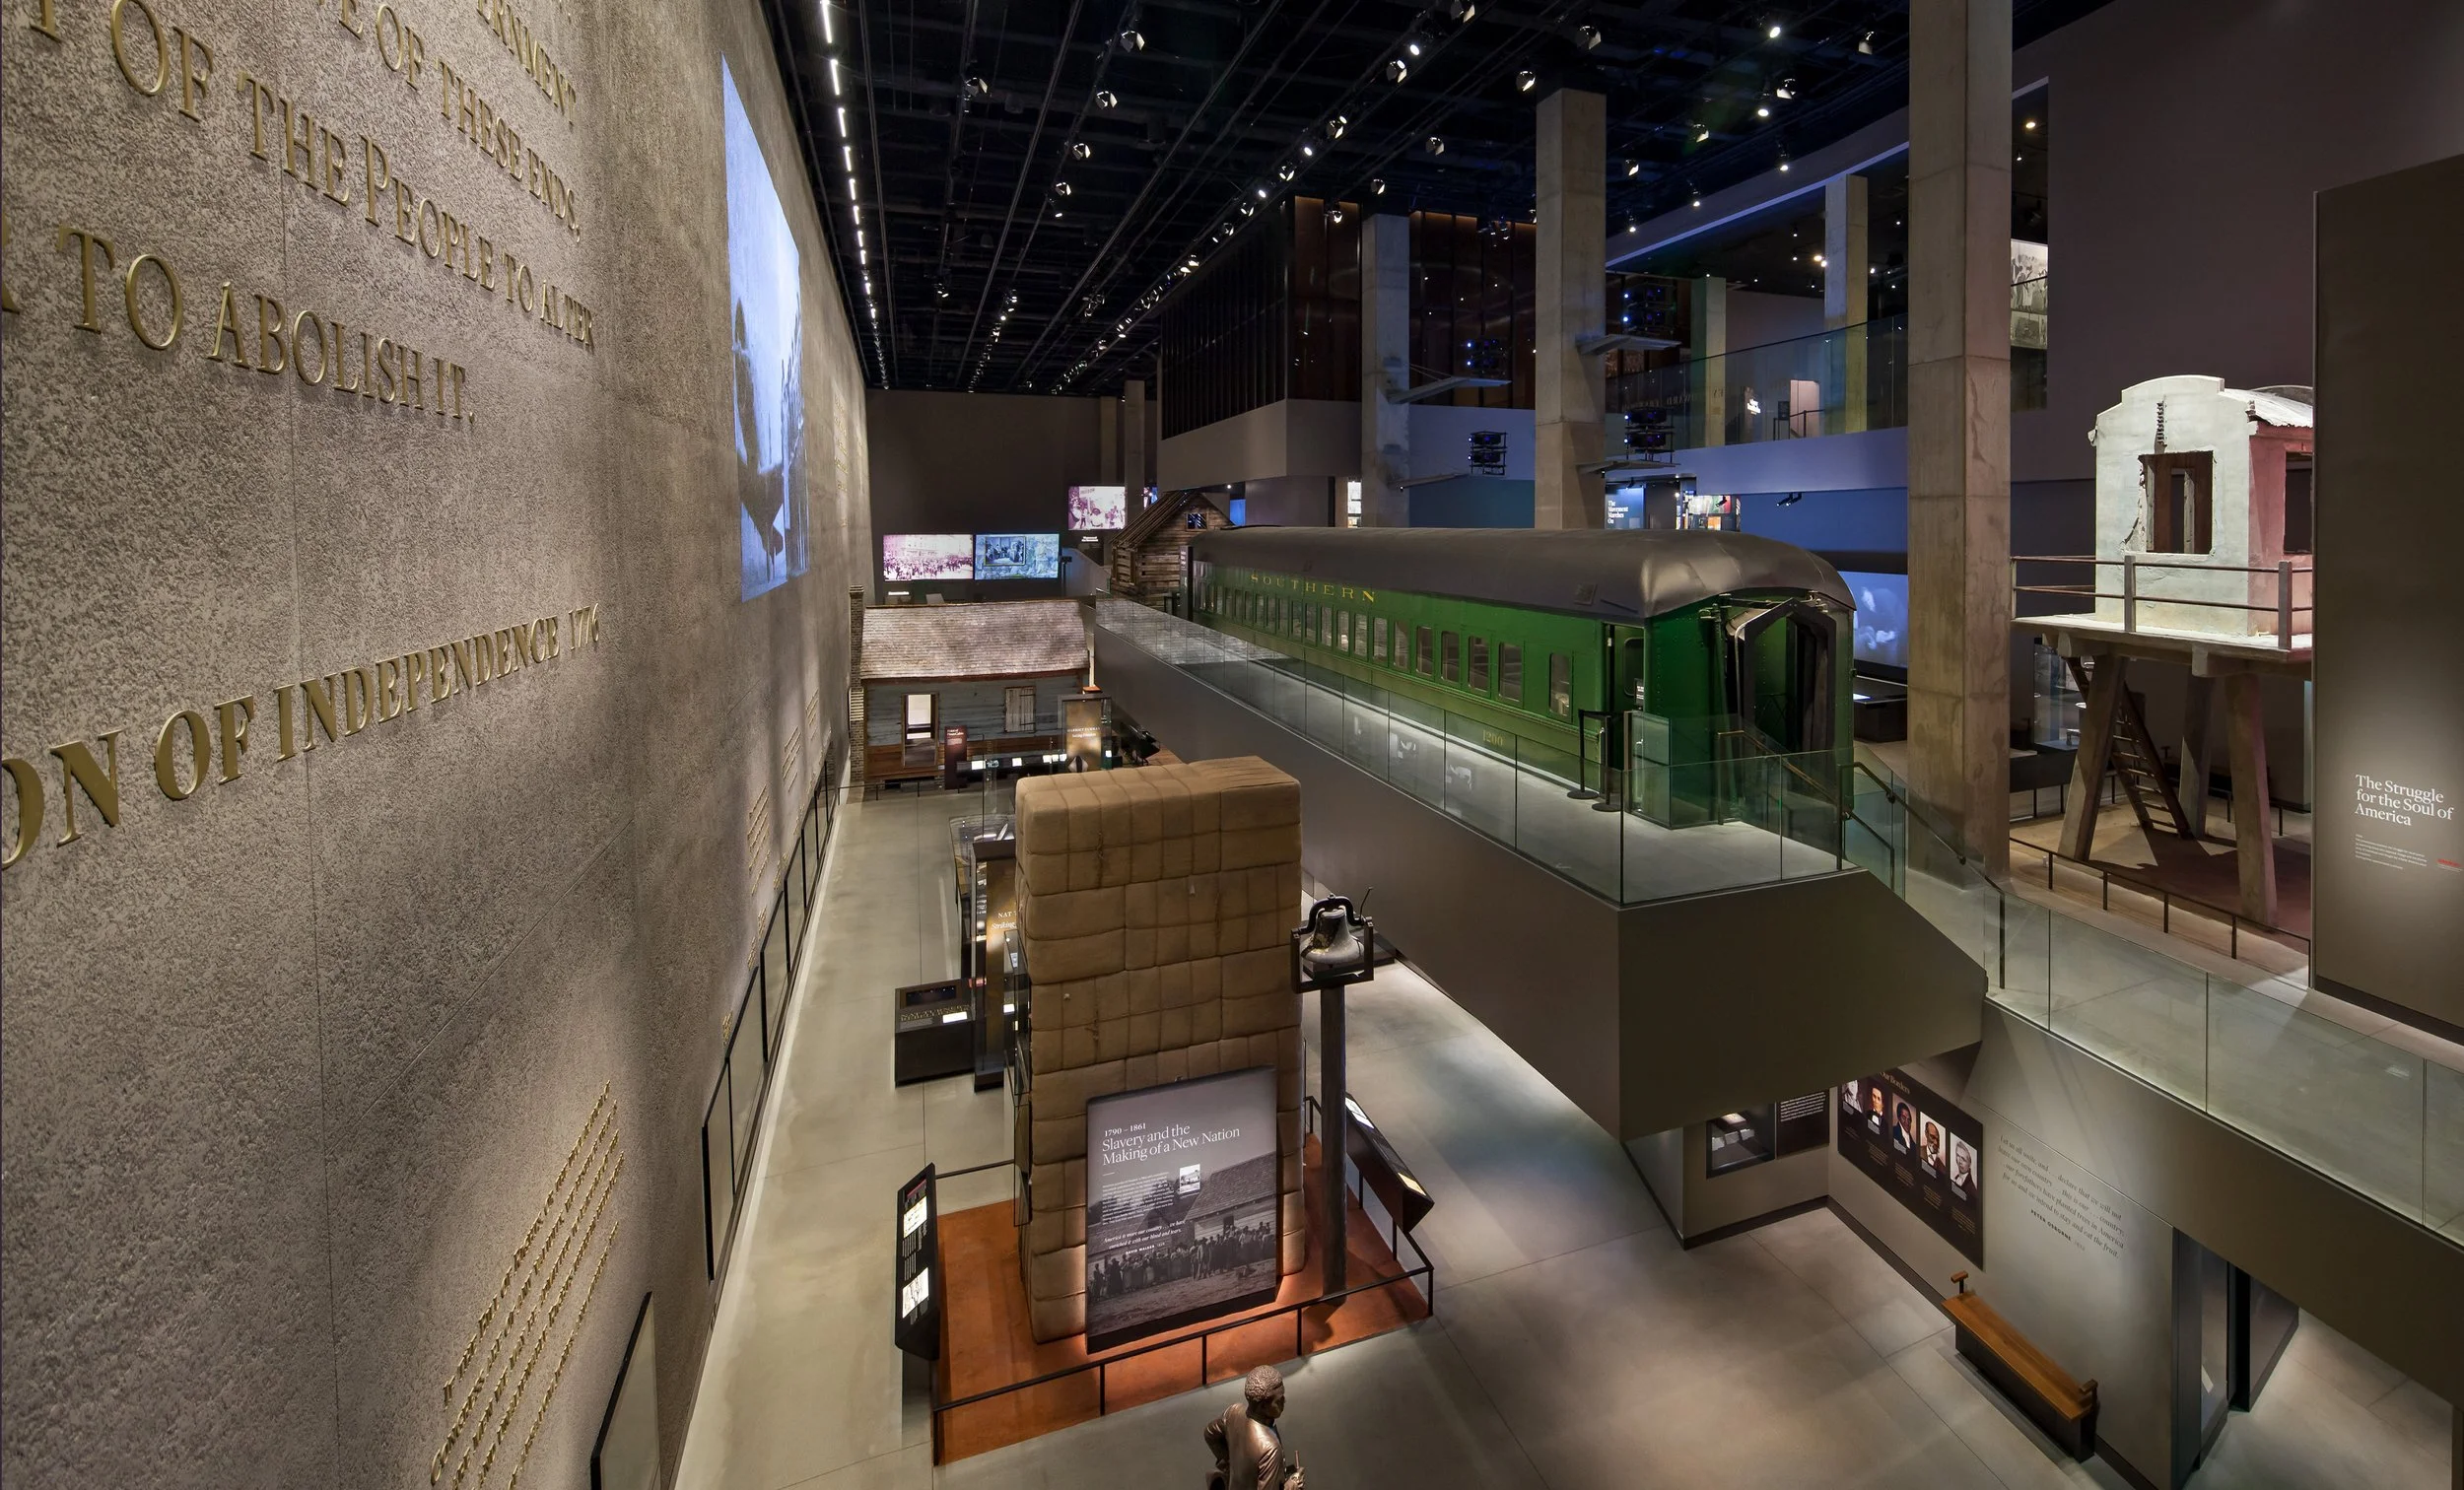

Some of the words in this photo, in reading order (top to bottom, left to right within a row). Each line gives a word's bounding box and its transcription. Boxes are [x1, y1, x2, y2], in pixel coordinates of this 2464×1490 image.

[376, 4, 424, 91] OF
[436, 56, 522, 182] THESE
[527, 148, 581, 242] ENDS,
[110, 0, 214, 122] OF
[237, 71, 350, 206] THE
[360, 134, 495, 292] PEOPLE
[502, 250, 534, 313] TO
[540, 280, 593, 347] ALTER
[57, 225, 184, 351] TO
[207, 281, 424, 409] ABOLISH
[433, 357, 476, 424] IT.
[1250, 573, 1376, 602] SOUTHERN
[154, 694, 255, 800] OF
[273, 615, 560, 761] INDEPENDENCE
[568, 602, 600, 651] 1776
[1482, 729, 1503, 746] 1200
[2355, 774, 2382, 790] The
[2384, 780, 2444, 805] Struggle
[2356, 788, 2376, 803] for
[2378, 793, 2401, 809] the
[2403, 798, 2435, 817] Soul
[2437, 807, 2454, 821] of
[2355, 803, 2412, 827] America
[1102, 1134, 1145, 1152] Slavery
[1147, 1126, 1169, 1143] and
[1171, 1123, 1191, 1137] the
[1104, 1127, 1122, 1137] 1790
[1130, 1122, 1145, 1132] 1861
[1103, 1147, 1147, 1166] Making
[1149, 1141, 1163, 1156] of
[1164, 1144, 1170, 1153] a
[1172, 1137, 1200, 1151] New
[1202, 1128, 1240, 1144] Nation
